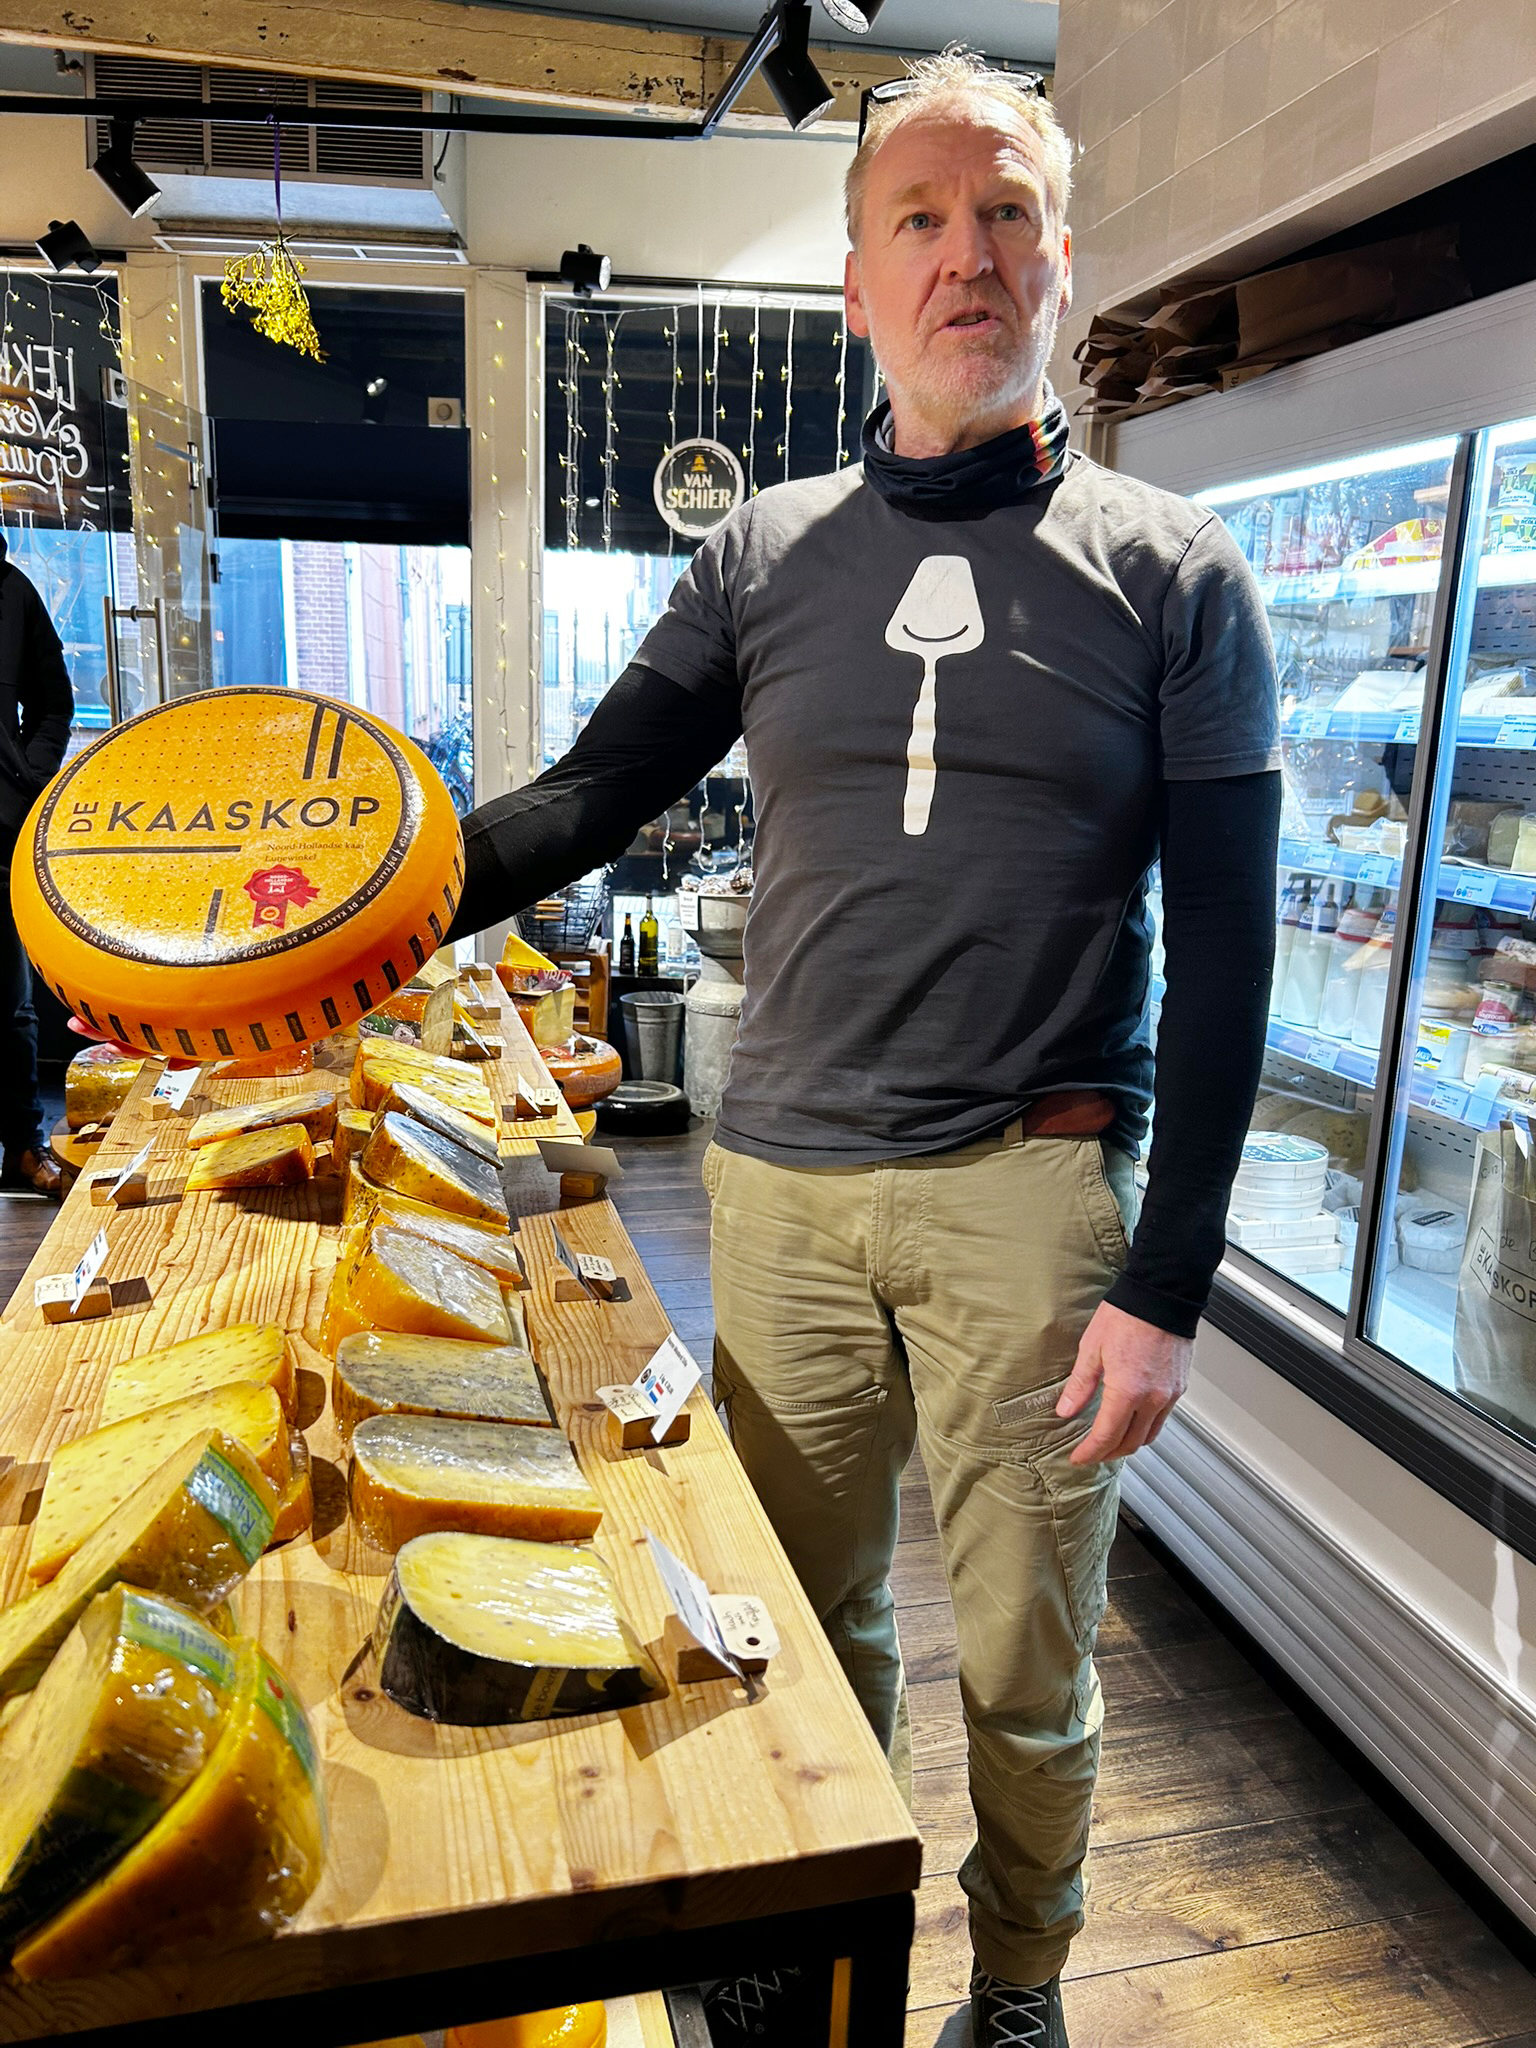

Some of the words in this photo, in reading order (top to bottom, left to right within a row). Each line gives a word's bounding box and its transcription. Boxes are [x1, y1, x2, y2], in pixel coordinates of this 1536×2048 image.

[683, 473, 713, 488] VAN
[666, 488, 732, 509] SCHIER
[67, 801, 100, 833] DE
[107, 796, 380, 833] KAASKOP
[366, 865, 392, 897] KAASKOP
[347, 901, 359, 913] DE
[311, 909, 349, 936] KAASKOP
[242, 942, 284, 958] KAASKOP
